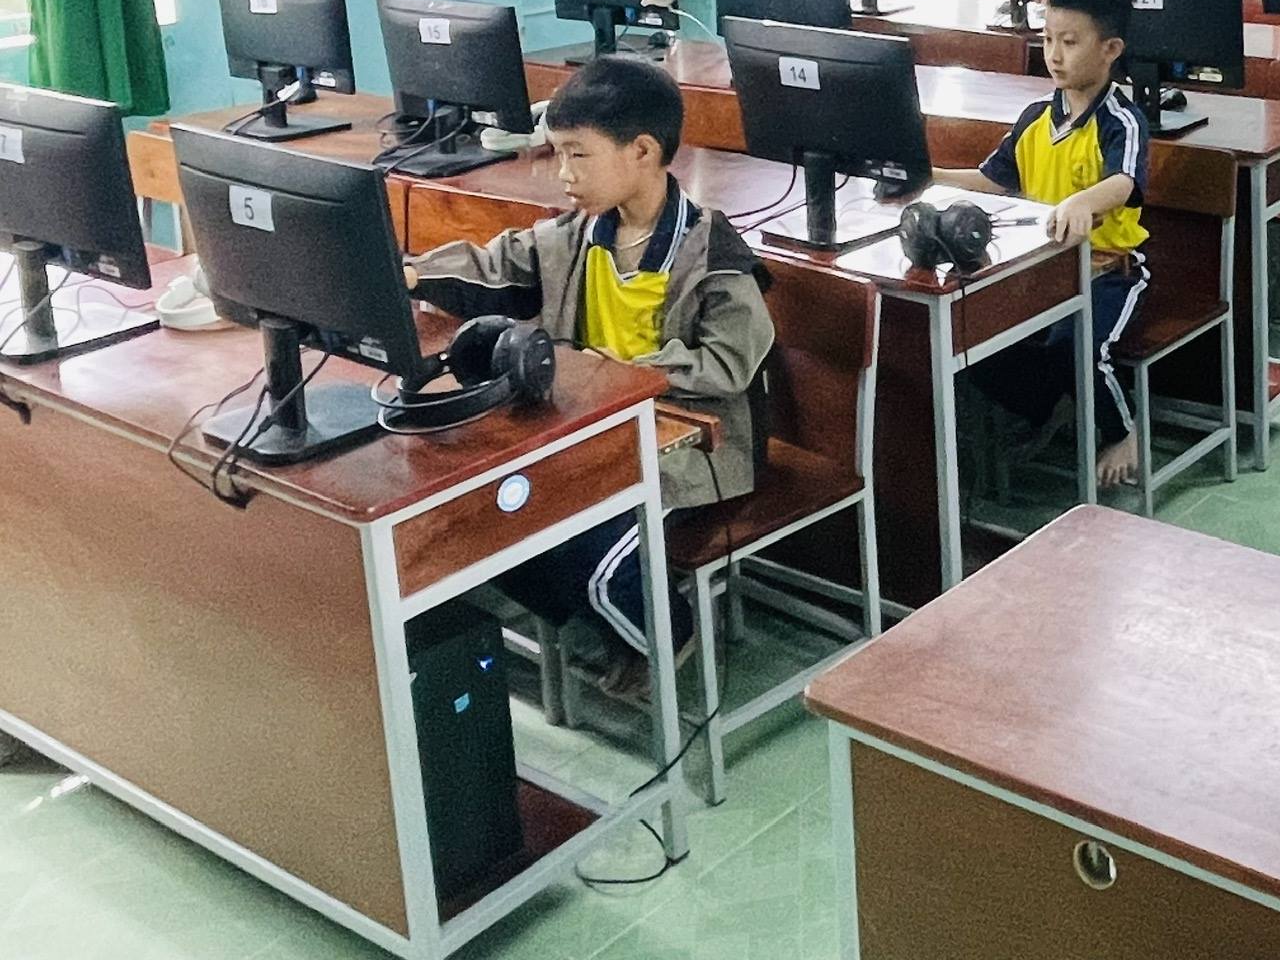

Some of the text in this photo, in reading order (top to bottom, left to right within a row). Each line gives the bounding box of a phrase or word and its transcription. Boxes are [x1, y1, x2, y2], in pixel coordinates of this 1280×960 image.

[427, 25, 441, 40] 15
[790, 66, 807, 83] 14
[244, 197, 254, 220] 5
